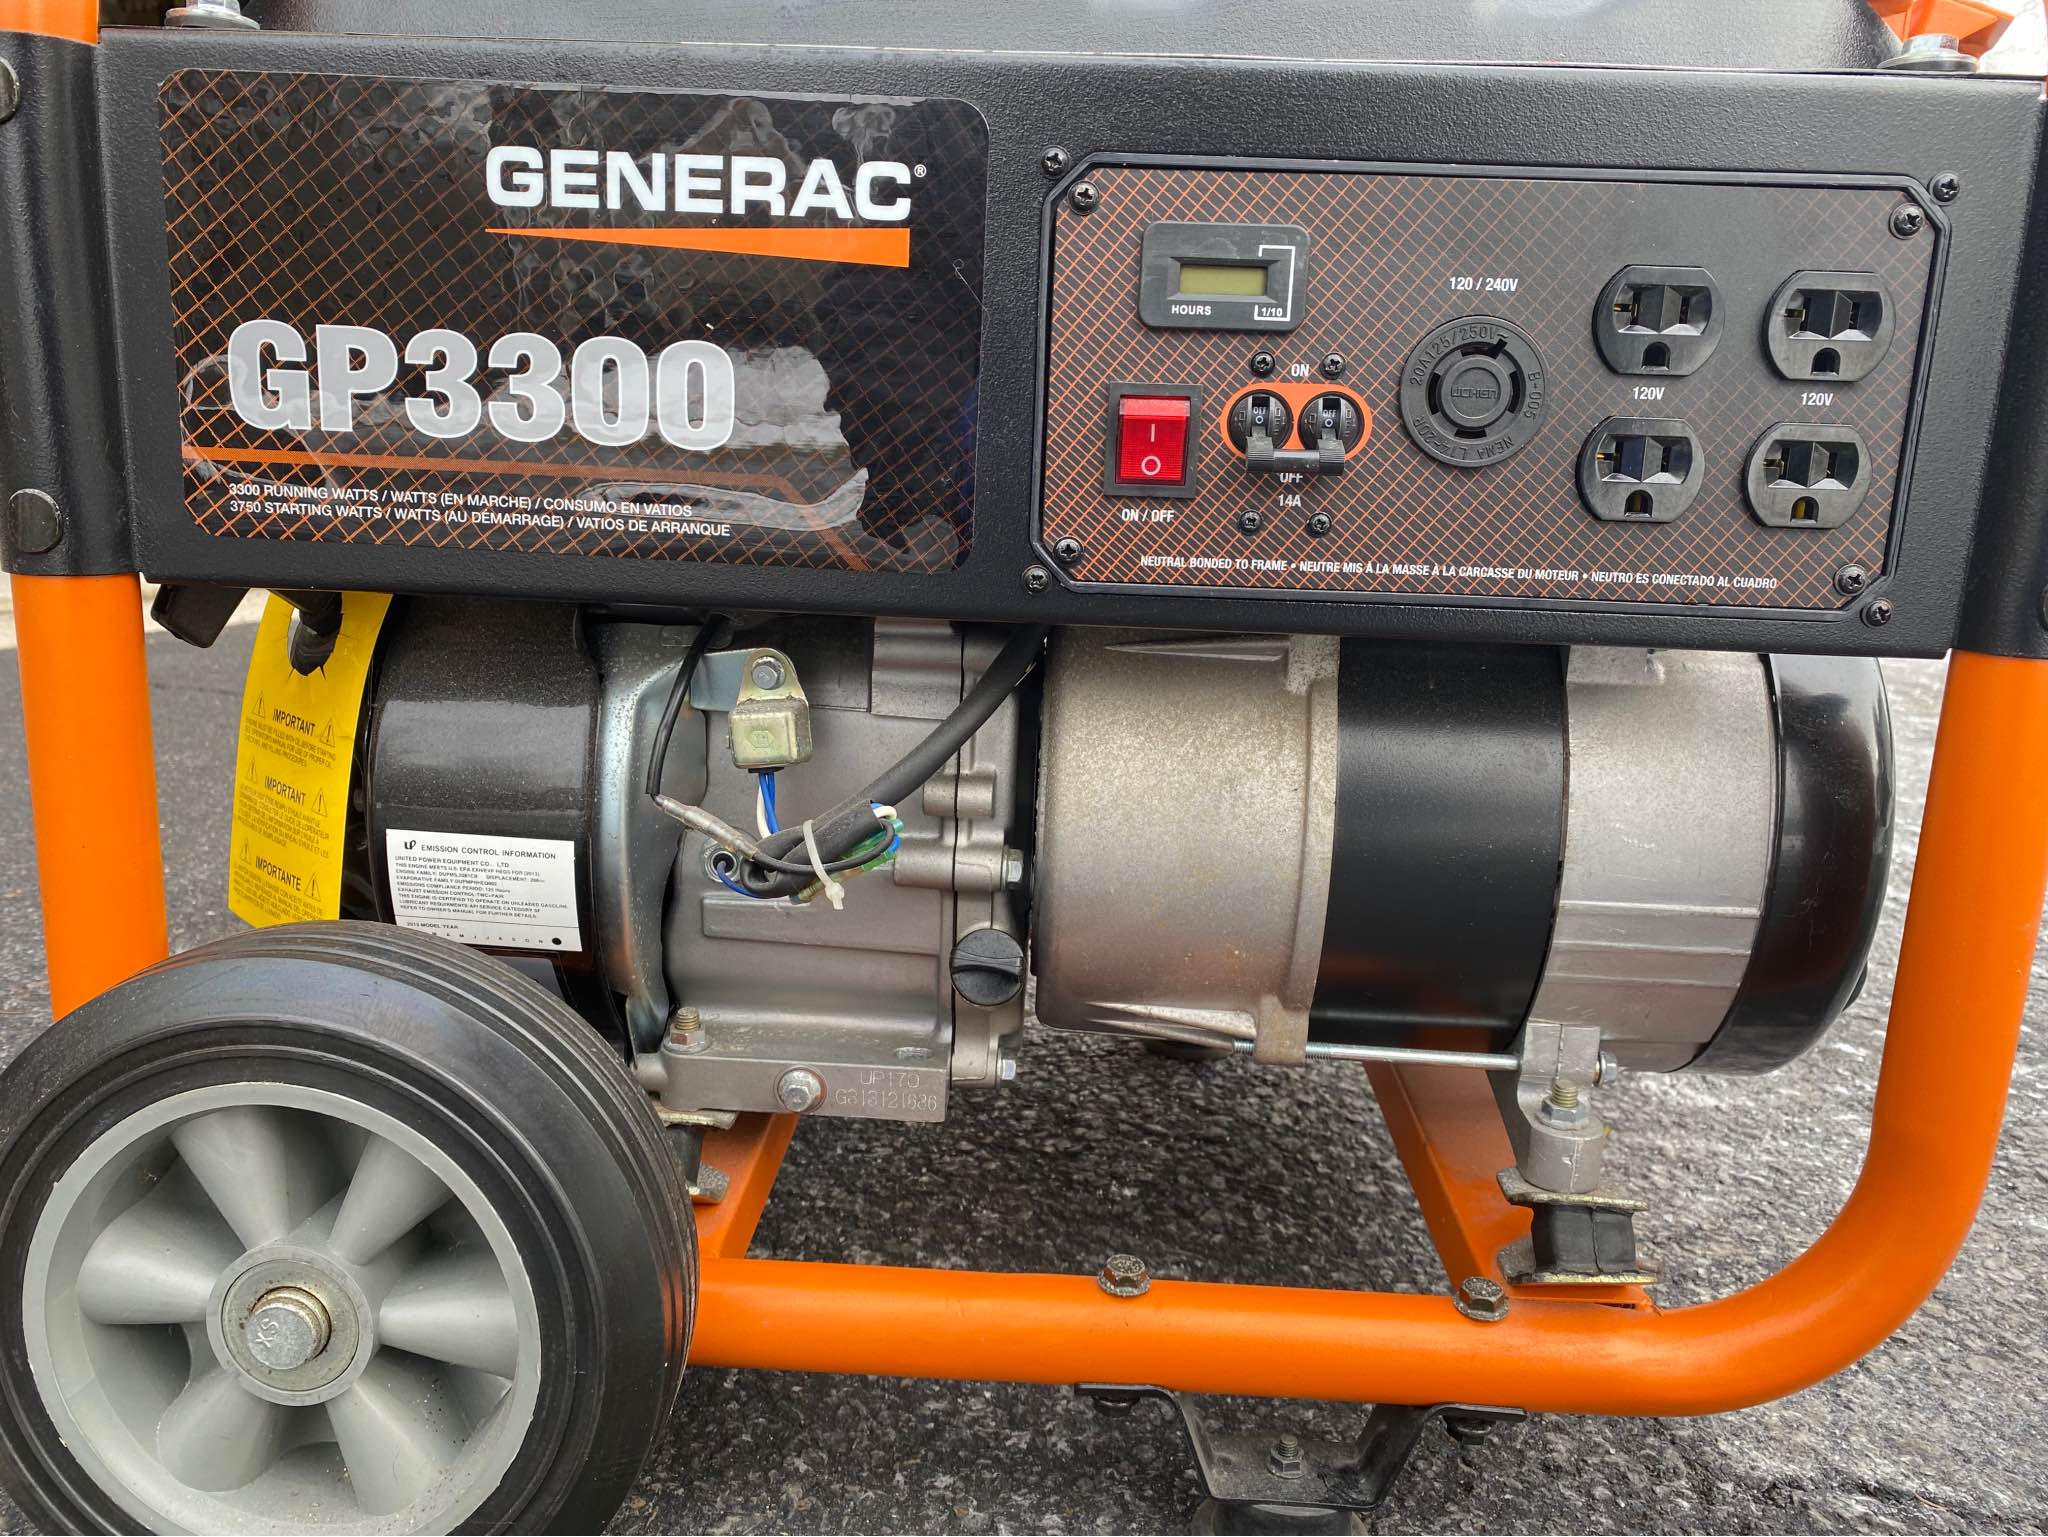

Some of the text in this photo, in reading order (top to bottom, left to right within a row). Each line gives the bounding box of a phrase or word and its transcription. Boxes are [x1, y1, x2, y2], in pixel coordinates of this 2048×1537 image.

[1449, 276, 1519, 292] 120 / 240V
[1171, 305, 1283, 317] HOURS 1/10
[1291, 364, 1310, 377] ON
[228, 319, 735, 451] GP3300
[1632, 386, 1666, 400] 120V
[1800, 392, 1834, 406] 120V
[229, 483, 260, 496] 3300
[264, 485, 328, 499] RUNNING
[332, 487, 379, 502] WATTS
[390, 490, 437, 505] WATTS
[440, 493, 463, 508] (EN
[467, 494, 532, 511] MARCHE)
[543, 498, 617, 515] CONSUMO
[620, 502, 640, 515] EN
[643, 503, 693, 518] VATIOS
[1279, 494, 1301, 508] 14A
[229, 500, 261, 514] 3750
[264, 501, 332, 518] STARTING
[335, 505, 383, 520] WATTS
[394, 507, 441, 521] WATTS
[444, 511, 467, 525] (AU
[471, 510, 564, 529] DÉMARRAGE)
[576, 516, 625, 531] VATIOS
[629, 519, 648, 532] DE
[651, 521, 731, 537] ARRANQUE
[1121, 508, 1139, 522] ON
[1151, 509, 1175, 523] OFF
[1140, 555, 1777, 589] NEUTRAL BONDED TO FRAME NEUTRE MIS À LA MASSE À LA CARCASSE DU MOTEUR NEUTRO ES CONECTADO AL CUADRO
[273, 708, 316, 736] IMPORTANT
[265, 776, 306, 806] IMPORTANT
[421, 844, 458, 853] EMISSION
[461, 847, 499, 856] CONTROL
[502, 849, 556, 859] INFORMATION
[443, 858, 479, 866] EQUIPMENT
[256, 856, 302, 891] IMPORTANTE
